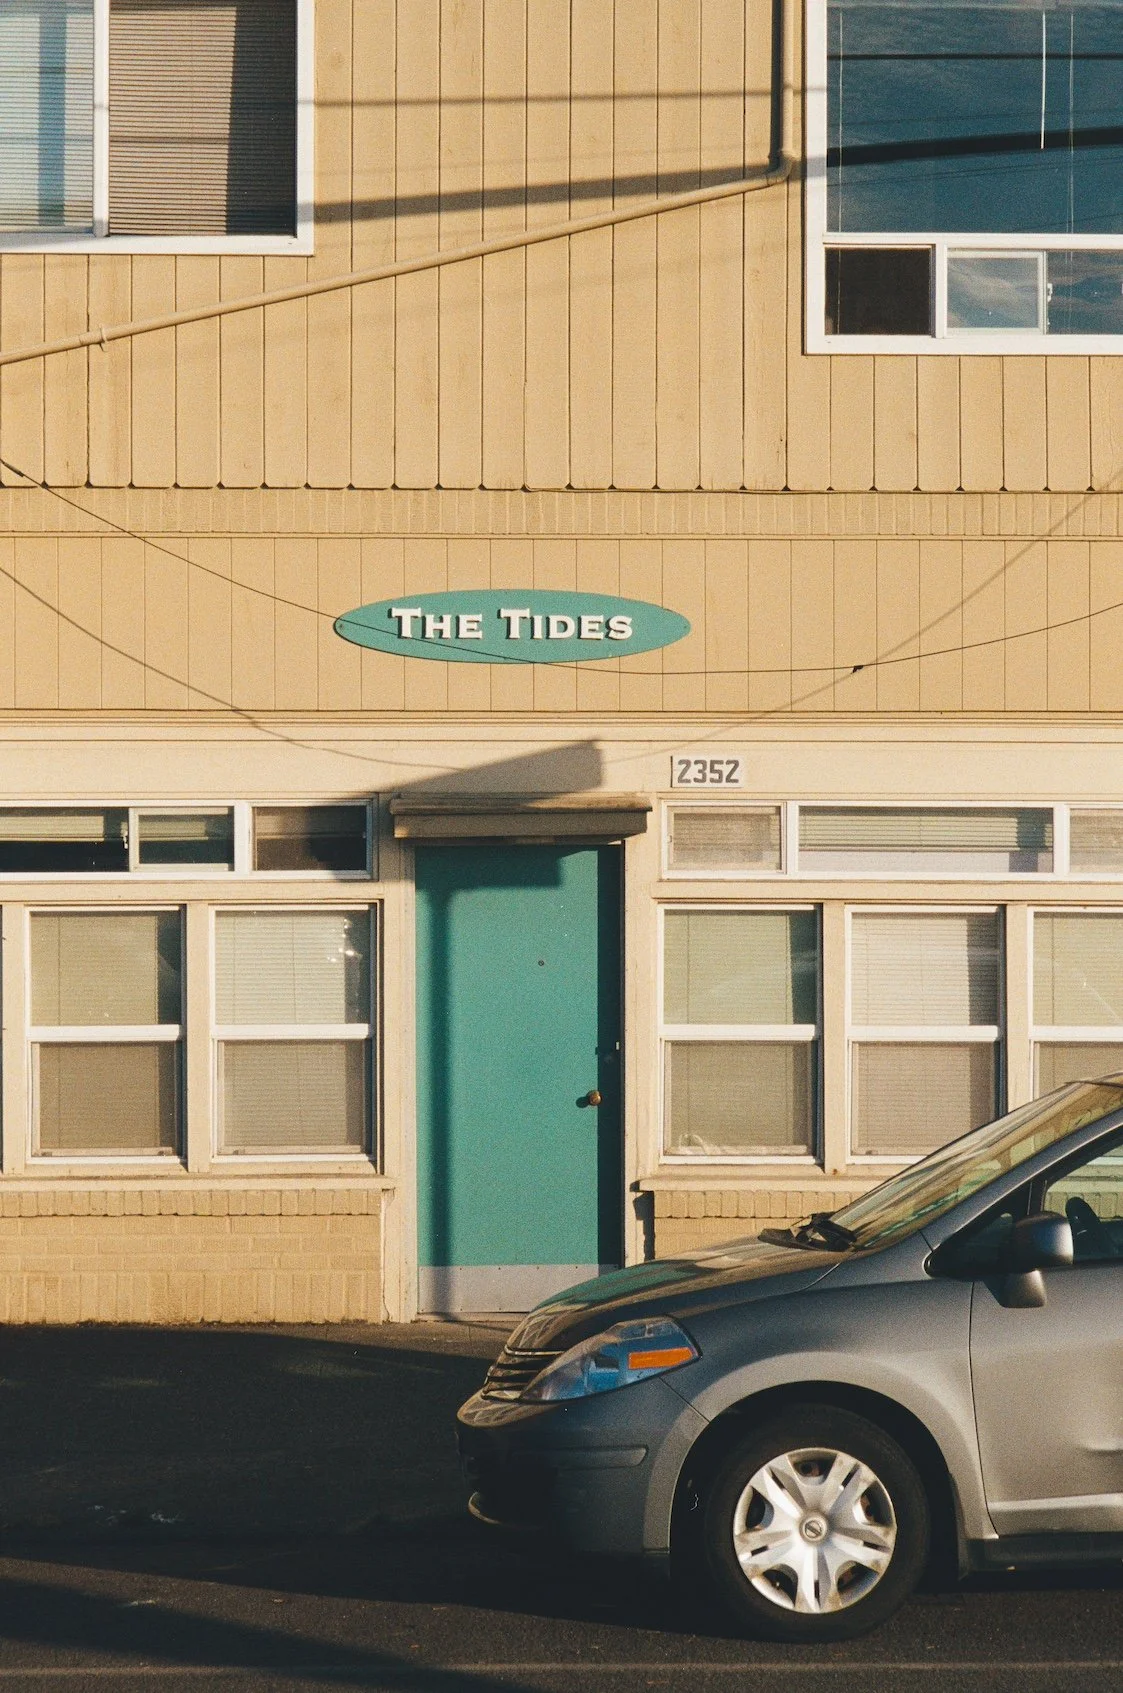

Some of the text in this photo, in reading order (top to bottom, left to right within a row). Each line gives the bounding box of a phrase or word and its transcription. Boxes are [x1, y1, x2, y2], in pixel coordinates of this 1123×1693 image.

[390, 607, 633, 641] THE TIDES
[676, 759, 740, 785] 2352
